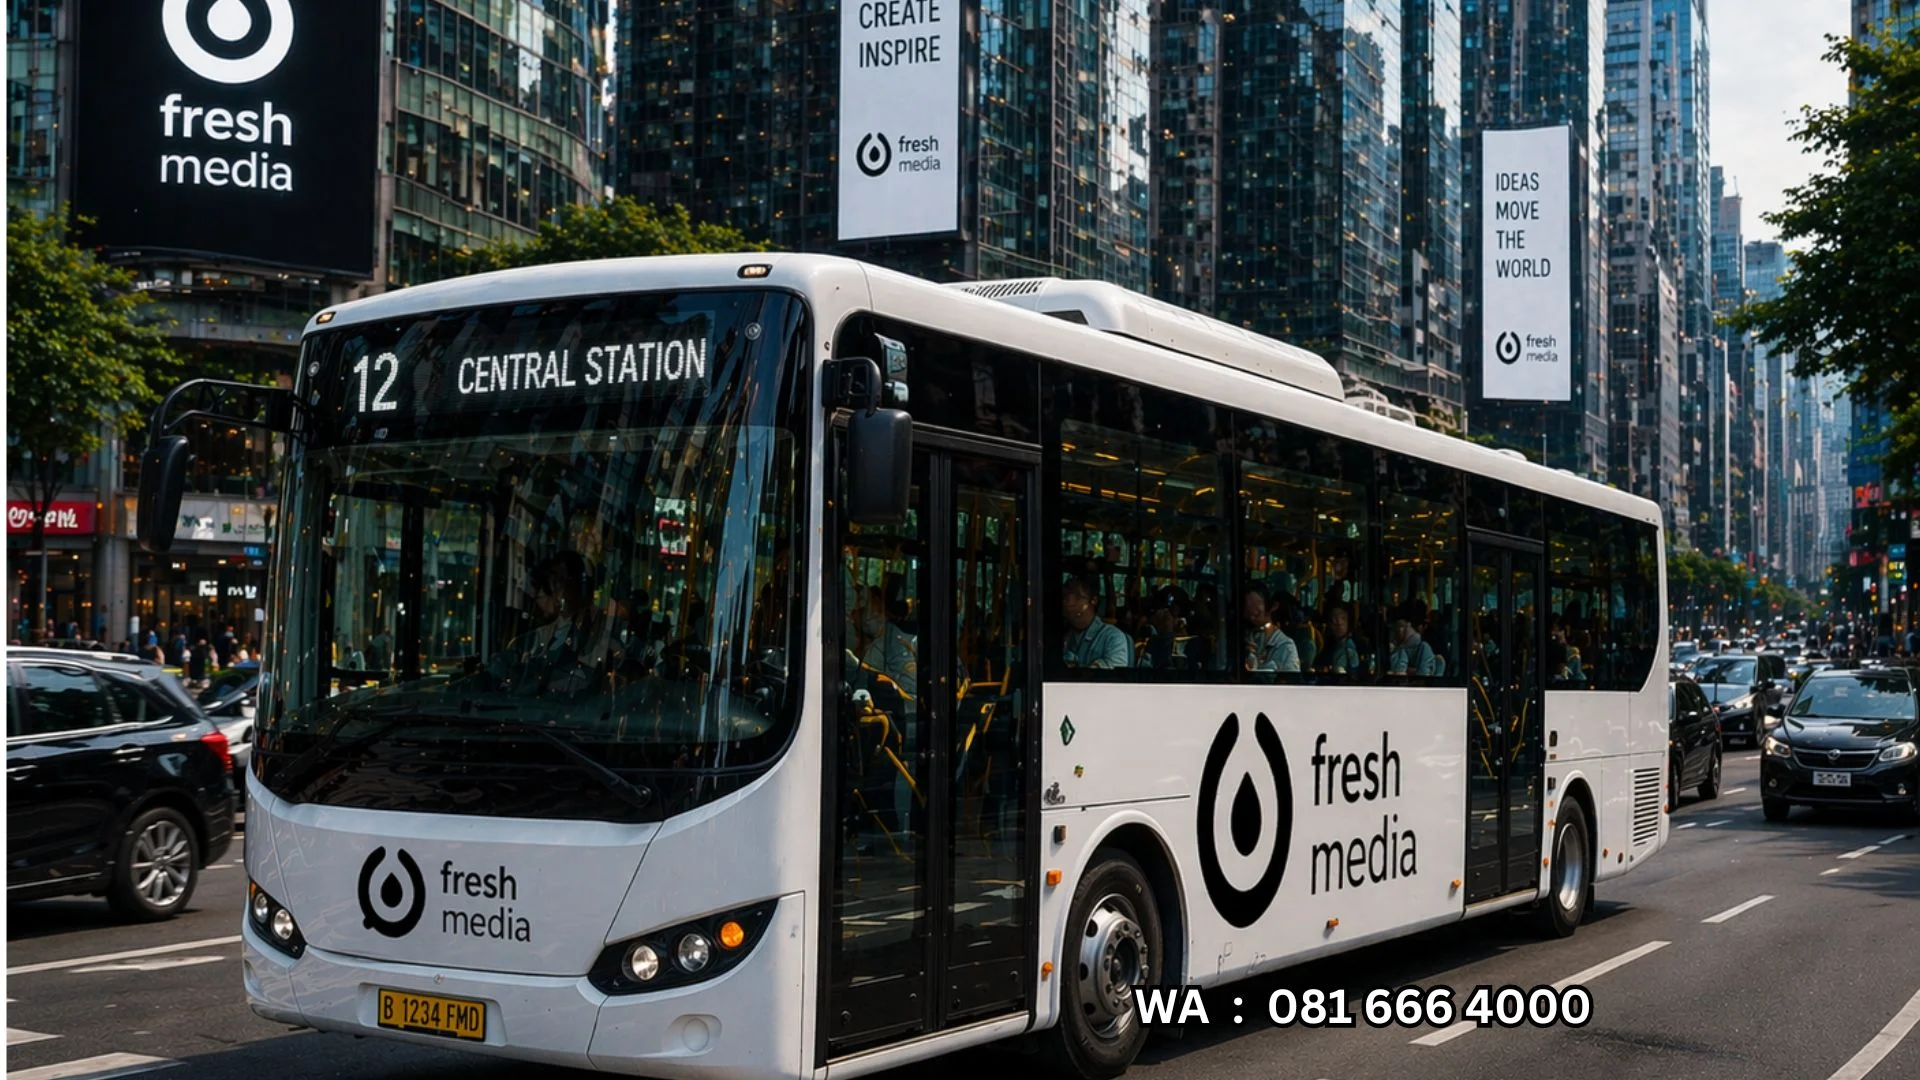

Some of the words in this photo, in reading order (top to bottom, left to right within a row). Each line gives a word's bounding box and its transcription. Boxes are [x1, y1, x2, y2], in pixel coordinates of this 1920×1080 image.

[859, 0, 941, 29] CREATE
[859, 35, 941, 68] INSPIRE
[160, 93, 292, 146] fresh
[898, 135, 939, 153] fresh
[160, 151, 293, 191] media
[898, 156, 941, 172] media
[1496, 172, 1540, 191] IDEAS
[1496, 200, 1540, 220] MOVE
[1496, 230, 1526, 249] THE
[1496, 258, 1551, 278] WORLD
[1526, 333, 1557, 348] fresh
[1526, 351, 1558, 362] media
[353, 352, 399, 413] 12
[458, 350, 577, 394] CENTRAL
[584, 337, 707, 386] STATION
[1311, 731, 1401, 806] fresh
[1311, 814, 1418, 895] media
[440, 860, 518, 900] fresh
[442, 906, 531, 942] media
[383, 995, 394, 1020] B
[402, 998, 442, 1027] 1234
[446, 1004, 480, 1032] FMD
